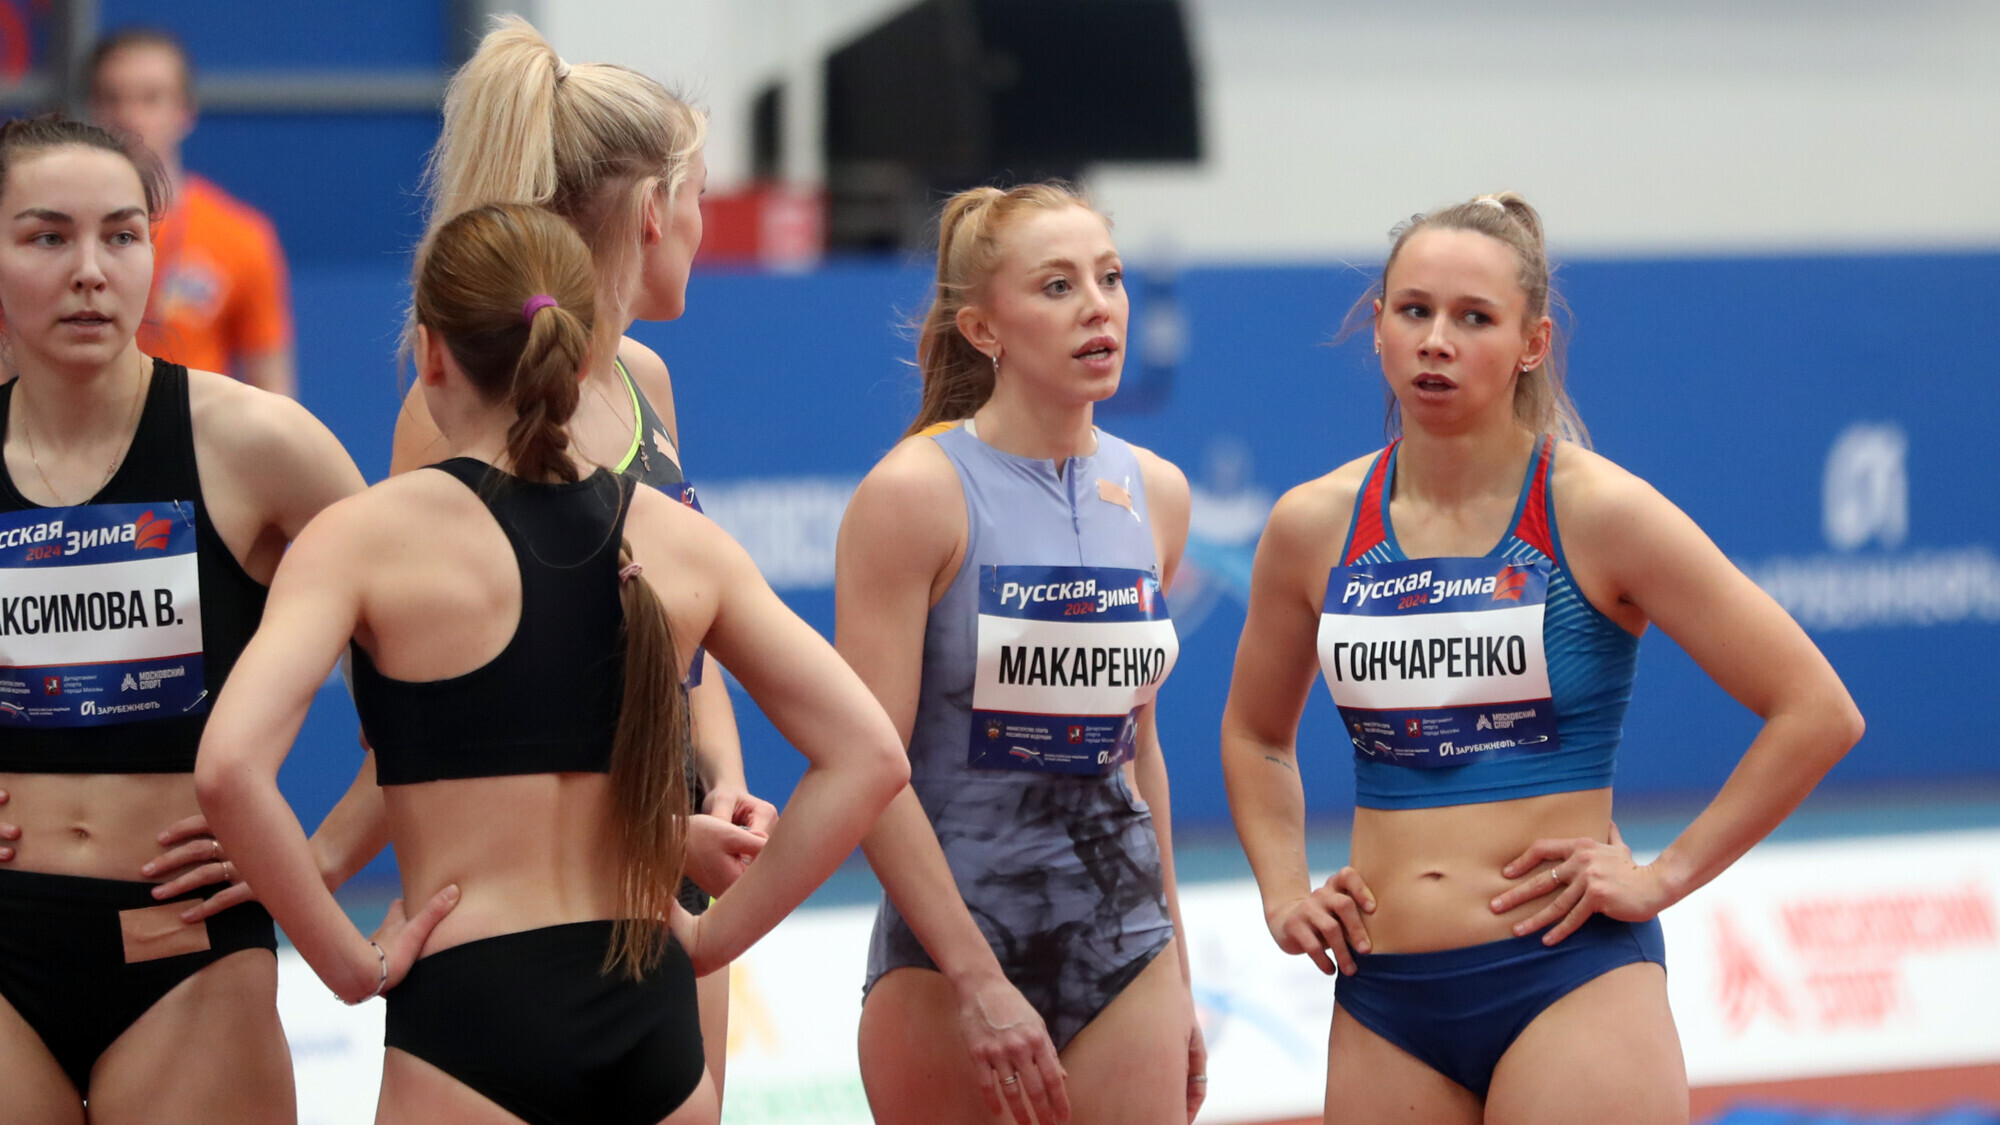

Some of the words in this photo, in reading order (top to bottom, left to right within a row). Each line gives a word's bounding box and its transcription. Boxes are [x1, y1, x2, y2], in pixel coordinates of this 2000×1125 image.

[64, 523, 136, 556] Зима
[26, 545, 62, 561] 2024
[1000, 579, 1096, 609] Русская
[1096, 585, 1138, 613] Зима
[1342, 570, 1433, 607] Русская
[1429, 575, 1497, 604] Зима
[1064, 602, 1095, 616] 2024
[1397, 594, 1428, 610] 2024
[0, 590, 148, 636] КСИМОВА
[154, 588, 184, 627] В.
[998, 645, 1166, 687] МАКАРЕНКО
[1333, 635, 1527, 682] ГОНЧАРЕНКО
[139, 665, 185, 680] МОСКОВСКИЙ
[140, 679, 162, 690] СПОРТ
[97, 701, 160, 715] ЗАРУБЕЖНЕФТЬ
[1492, 708, 1536, 721] МОСКОВСКИЙ
[1493, 720, 1514, 730] СПОРТ
[1455, 739, 1516, 755] ЗАРУБЕЖНЕФТЬ
